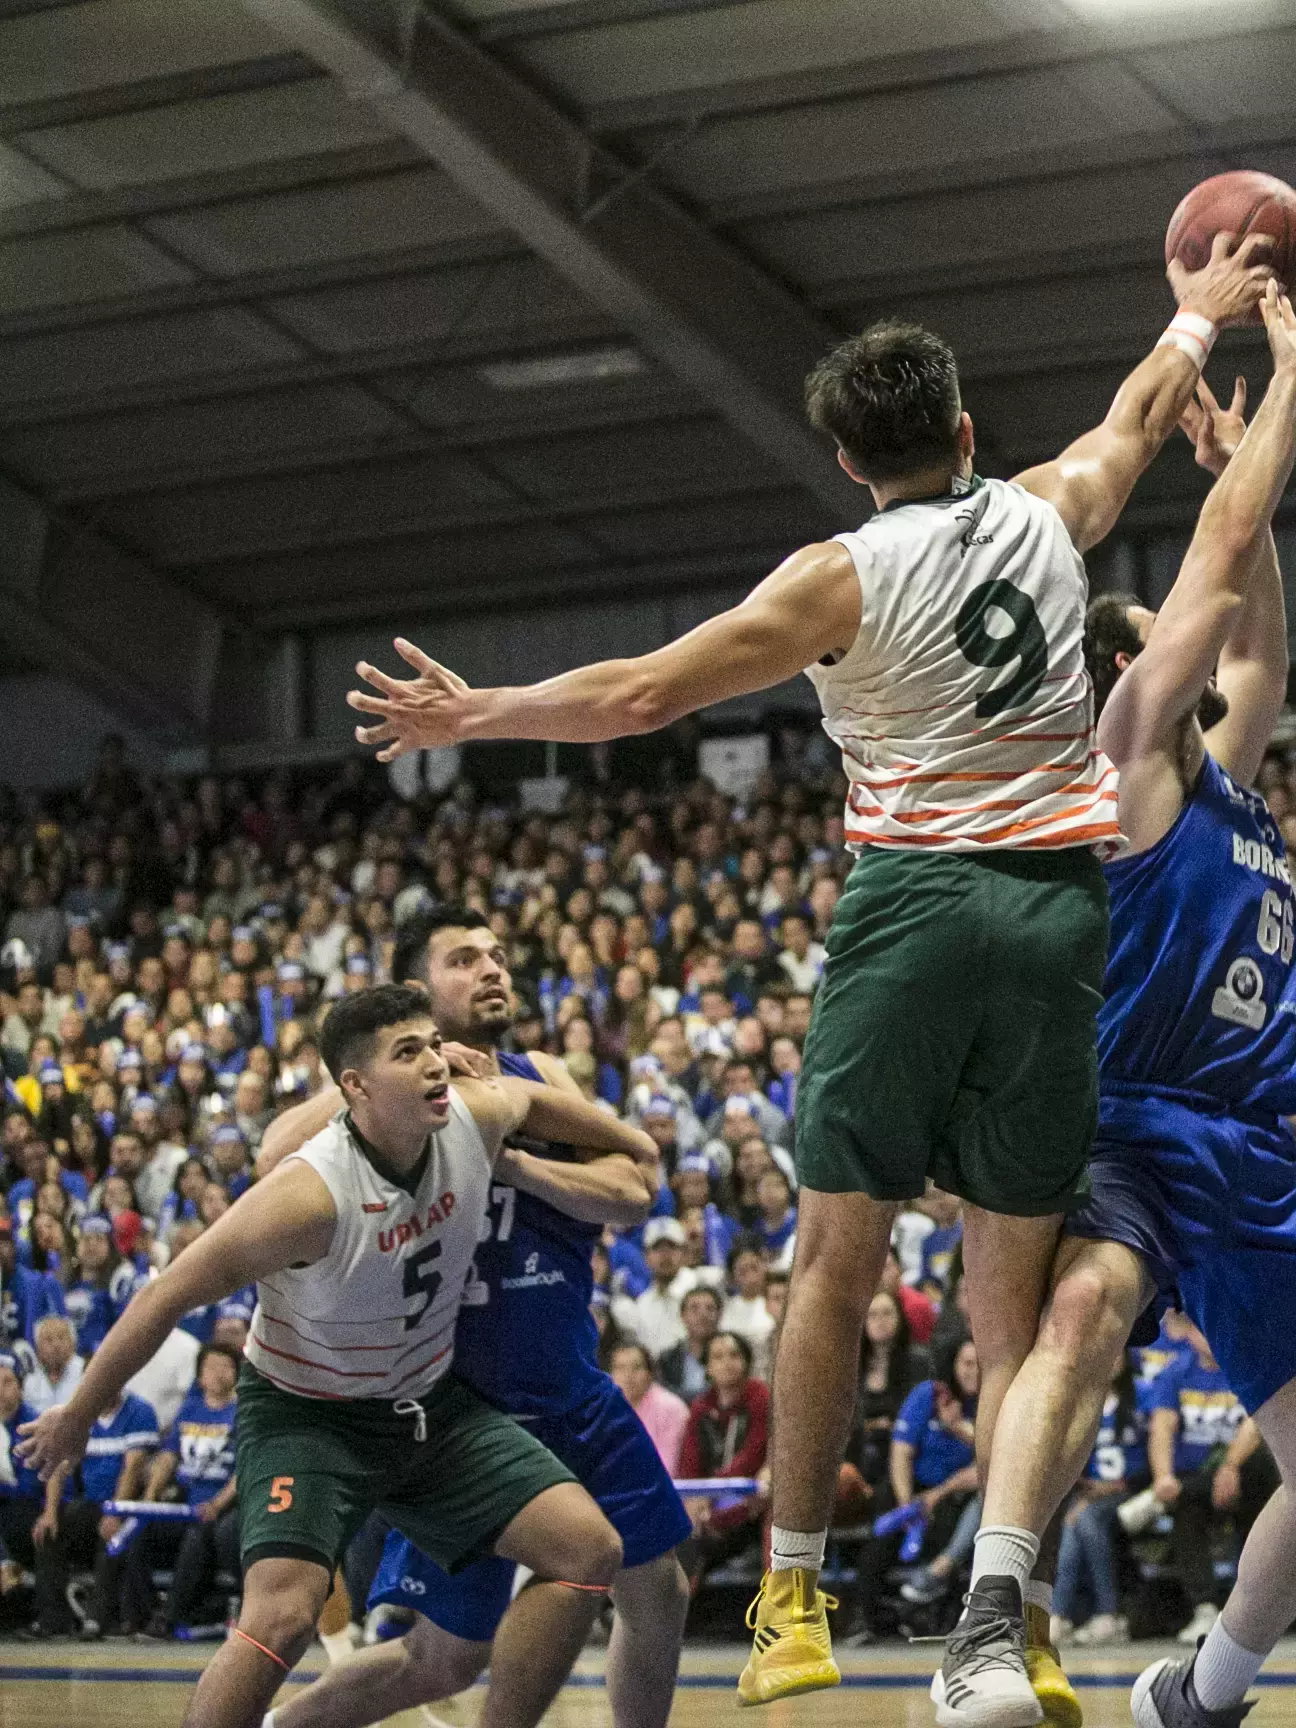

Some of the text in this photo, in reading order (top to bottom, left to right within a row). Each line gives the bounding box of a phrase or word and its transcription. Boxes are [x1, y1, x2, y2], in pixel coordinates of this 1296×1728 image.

[955, 577, 1049, 719] 9
[1257, 888, 1295, 966] 66
[402, 1239, 444, 1332] 5
[267, 1476, 295, 1513] 5
